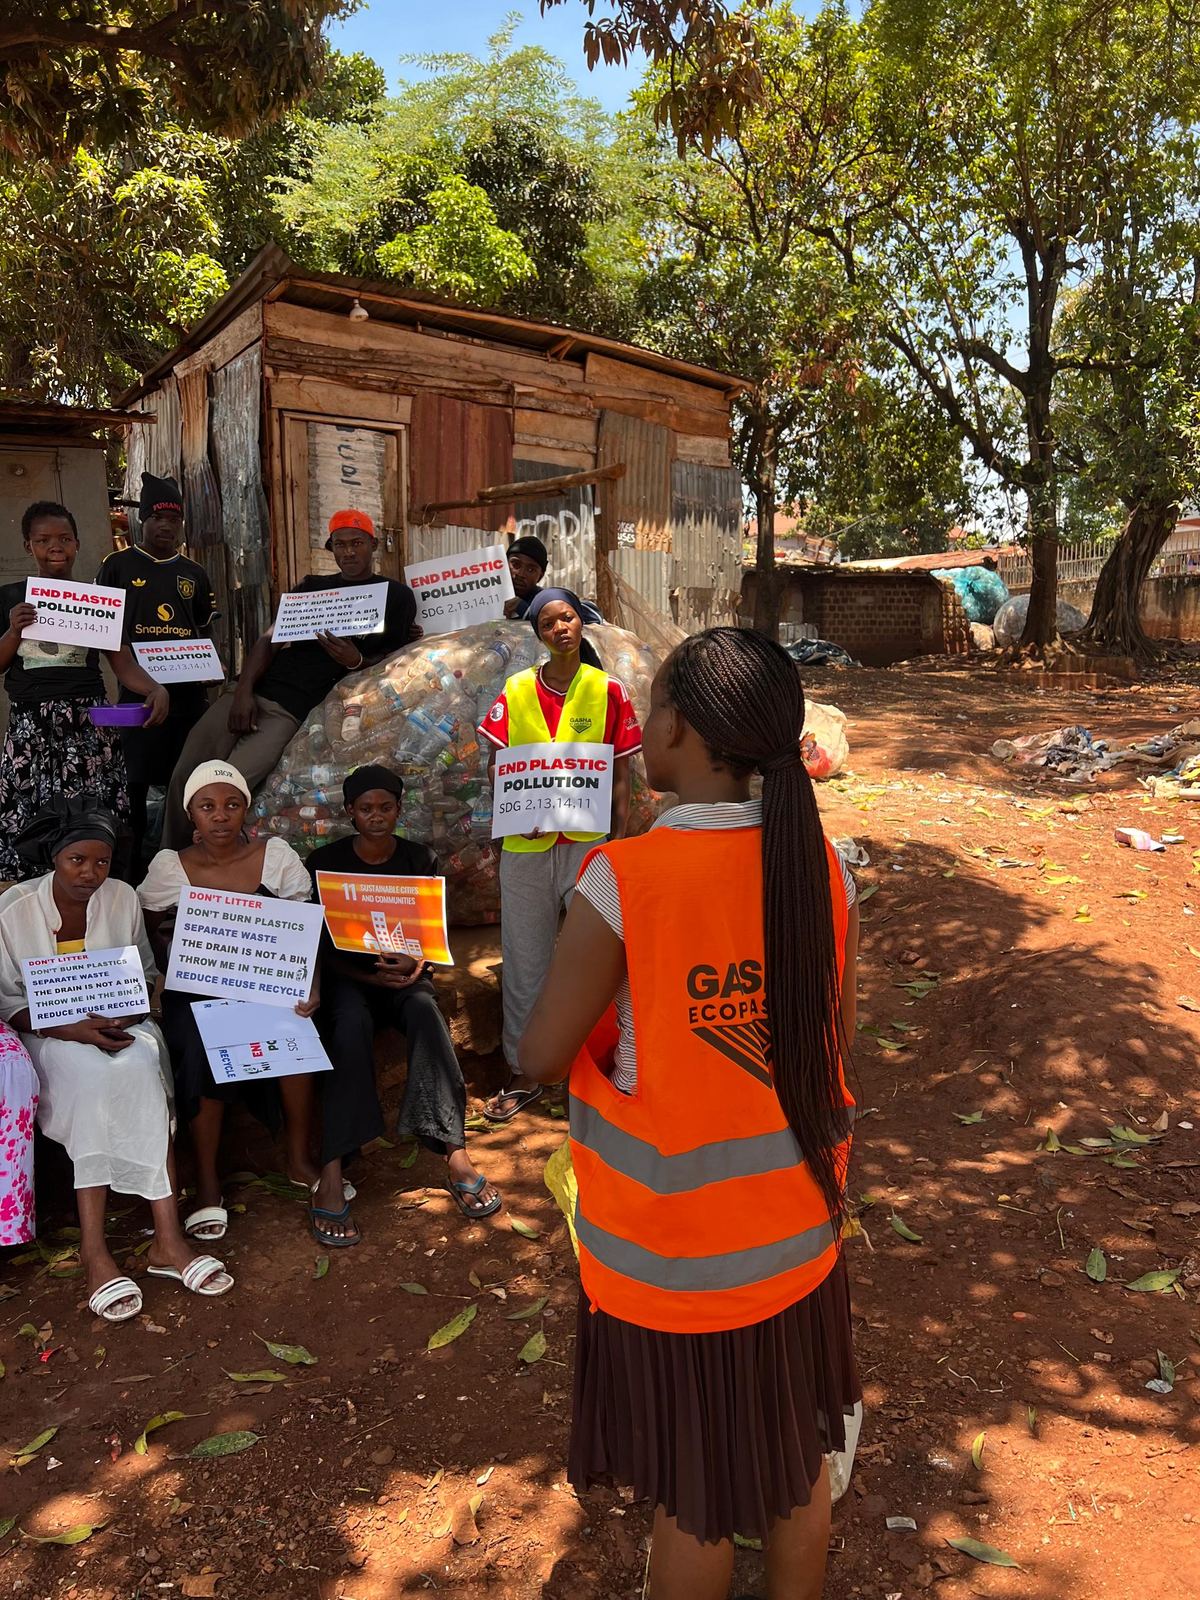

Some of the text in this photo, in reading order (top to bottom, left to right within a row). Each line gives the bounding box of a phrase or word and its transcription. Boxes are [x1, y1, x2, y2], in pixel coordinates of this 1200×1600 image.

[410, 559, 504, 589] END PLASTIC
[312, 591, 340, 599] LITTER
[421, 575, 502, 602] POLLUTION
[31, 587, 122, 608] END PLASTIC
[335, 594, 373, 603] PLASTICS
[38, 601, 116, 620] POLLUTION
[282, 607, 322, 615] SEPARATE
[421, 606, 445, 619] SDG
[278, 629, 310, 637] REDUCE
[312, 626, 340, 634] REUSE
[280, 622, 308, 630] THROW
[148, 652, 212, 662] POLLUTION
[164, 644, 212, 653] PLASTIC
[498, 758, 608, 777] END PLASTIC
[504, 776, 600, 794] POLLUTION
[499, 800, 521, 814] SDG
[342, 882, 357, 901] 11
[360, 884, 419, 896] SUSTAINABLE CITIES
[189, 892, 262, 909] DON'T LITTER
[362, 894, 416, 904] AND COMMUNITIES
[187, 907, 305, 931] DON'T BURN PLASTICS
[184, 923, 277, 943] SEPARATE WASTE
[29, 955, 89, 966] DON'T LITTER
[182, 939, 203, 948] THE
[206, 943, 238, 954] DRAIN
[241, 948, 252, 956] IS
[255, 950, 277, 960] NOT
[290, 956, 307, 965] BIN
[31, 968, 57, 976] DON'T
[87, 959, 127, 969] PLASTICS
[179, 955, 294, 979] THROW ME IN THE BIN
[32, 971, 110, 986] SEPARATE WASTE
[176, 970, 305, 997] REDUCE REUSE RECYCLE
[55, 985, 82, 994] DRAIN
[36, 999, 68, 1008] THROW
[37, 999, 146, 1020] REDUCE REUSE RECYCLE
[218, 1050, 236, 1078] RECYCLE
